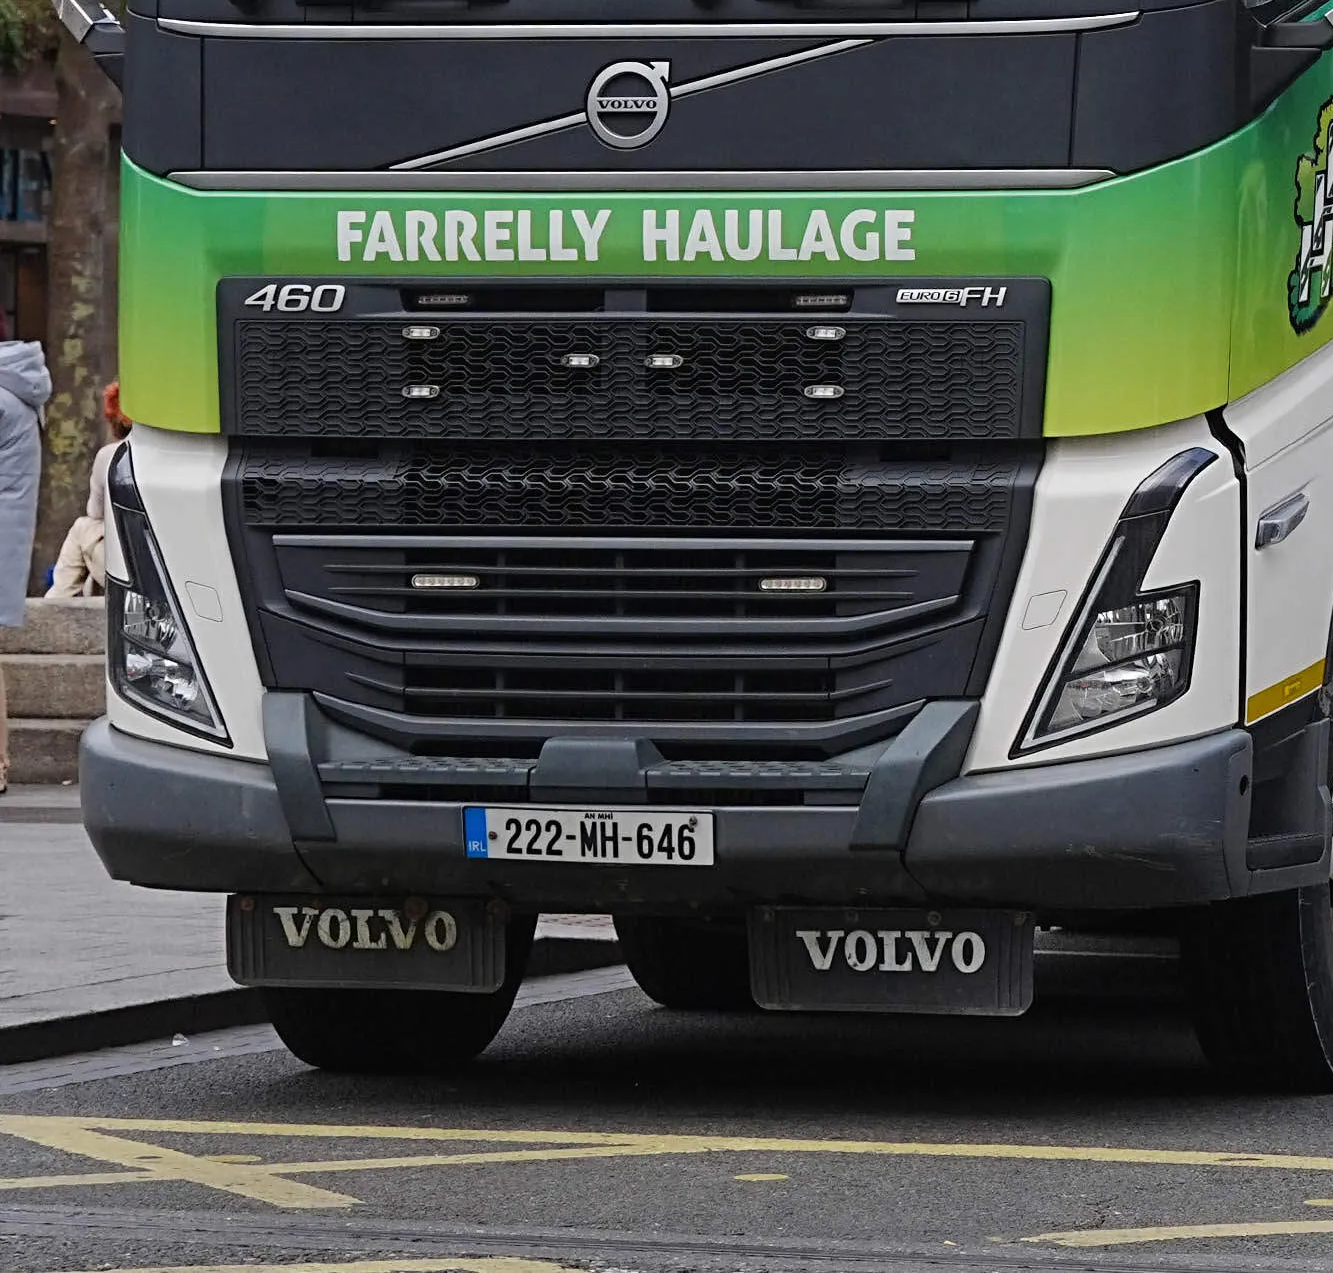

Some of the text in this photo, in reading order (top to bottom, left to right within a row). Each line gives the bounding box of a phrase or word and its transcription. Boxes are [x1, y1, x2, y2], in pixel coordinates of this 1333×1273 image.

[597, 99, 657, 110] VOLVO
[336, 209, 916, 264] FARRELLY HAULAGE
[243, 281, 347, 314] 460
[960, 287, 1007, 307] FH
[584, 812, 596, 821] AN
[468, 840, 487, 853] IRL
[504, 818, 697, 861] 222-MH-646
[273, 905, 458, 952] VOLVO
[796, 928, 987, 975] VOLVO
